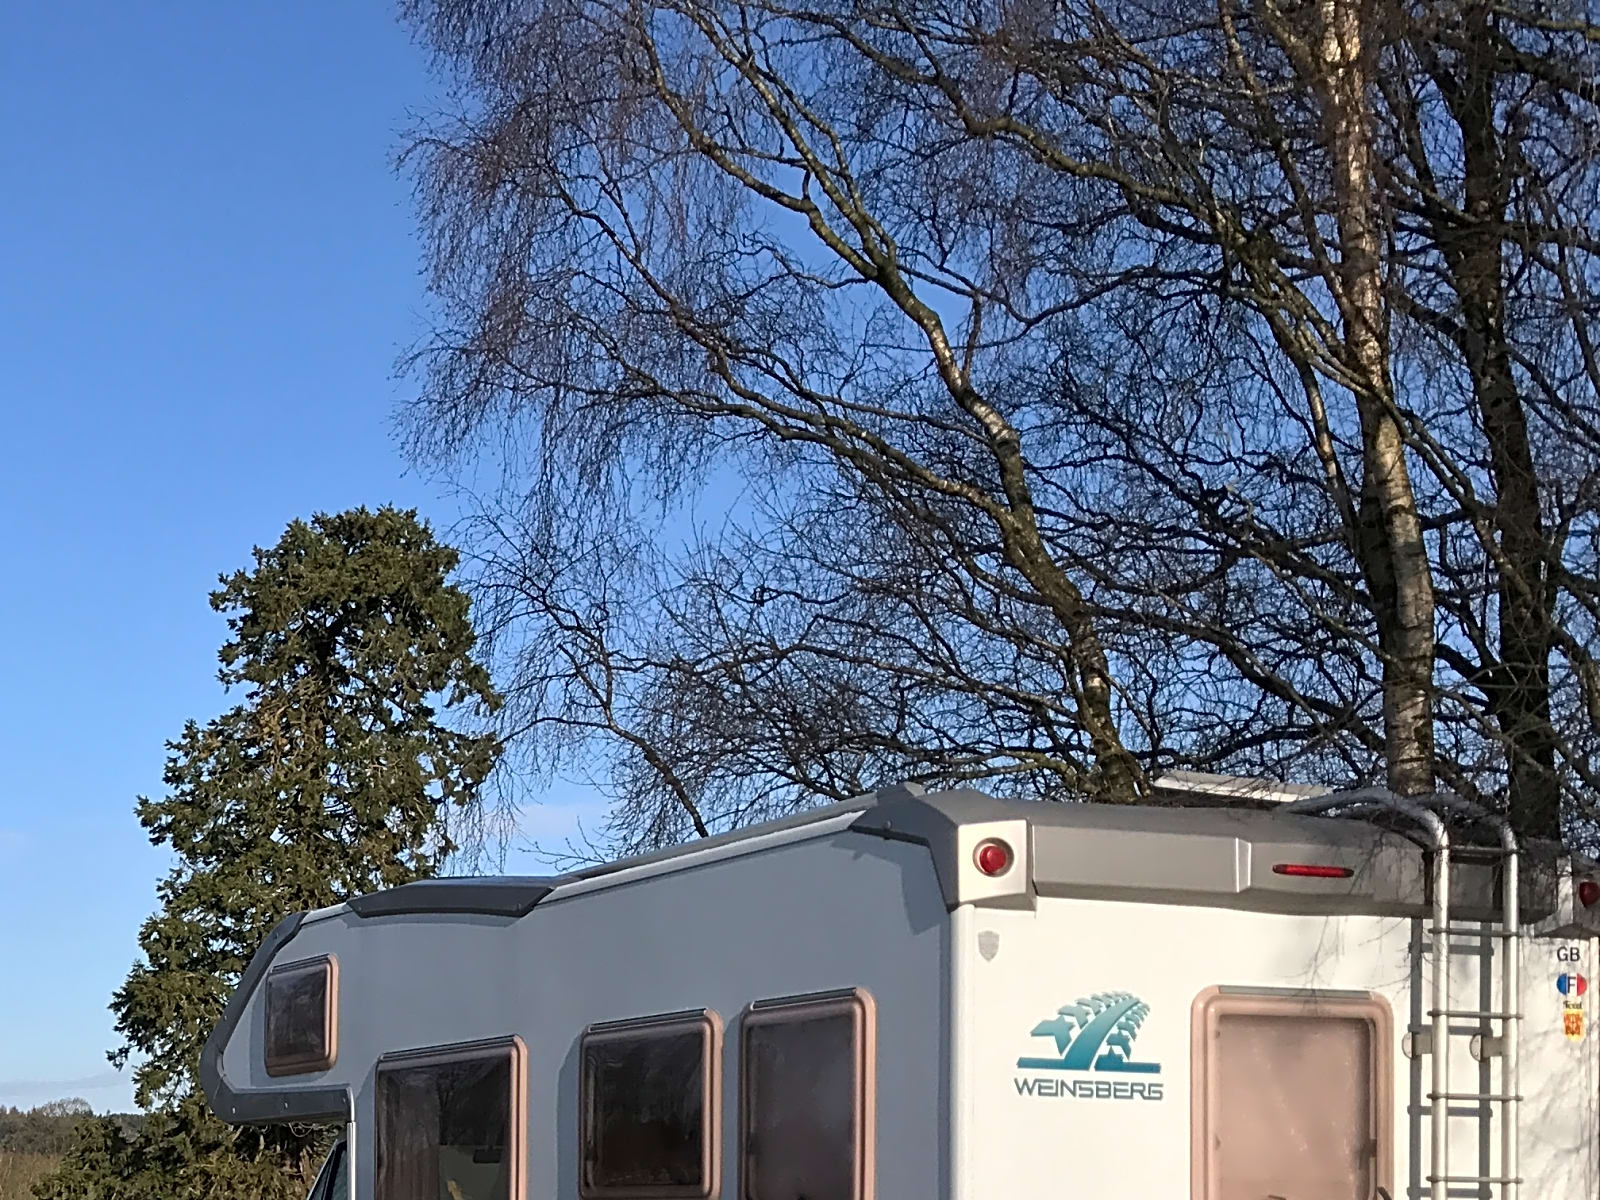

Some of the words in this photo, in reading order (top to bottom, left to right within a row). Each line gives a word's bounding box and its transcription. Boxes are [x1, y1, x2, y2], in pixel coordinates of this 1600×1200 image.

[1557, 947, 1580, 962] GB
[1567, 976, 1576, 994] F
[1014, 1077, 1164, 1101] WEINSBERG
